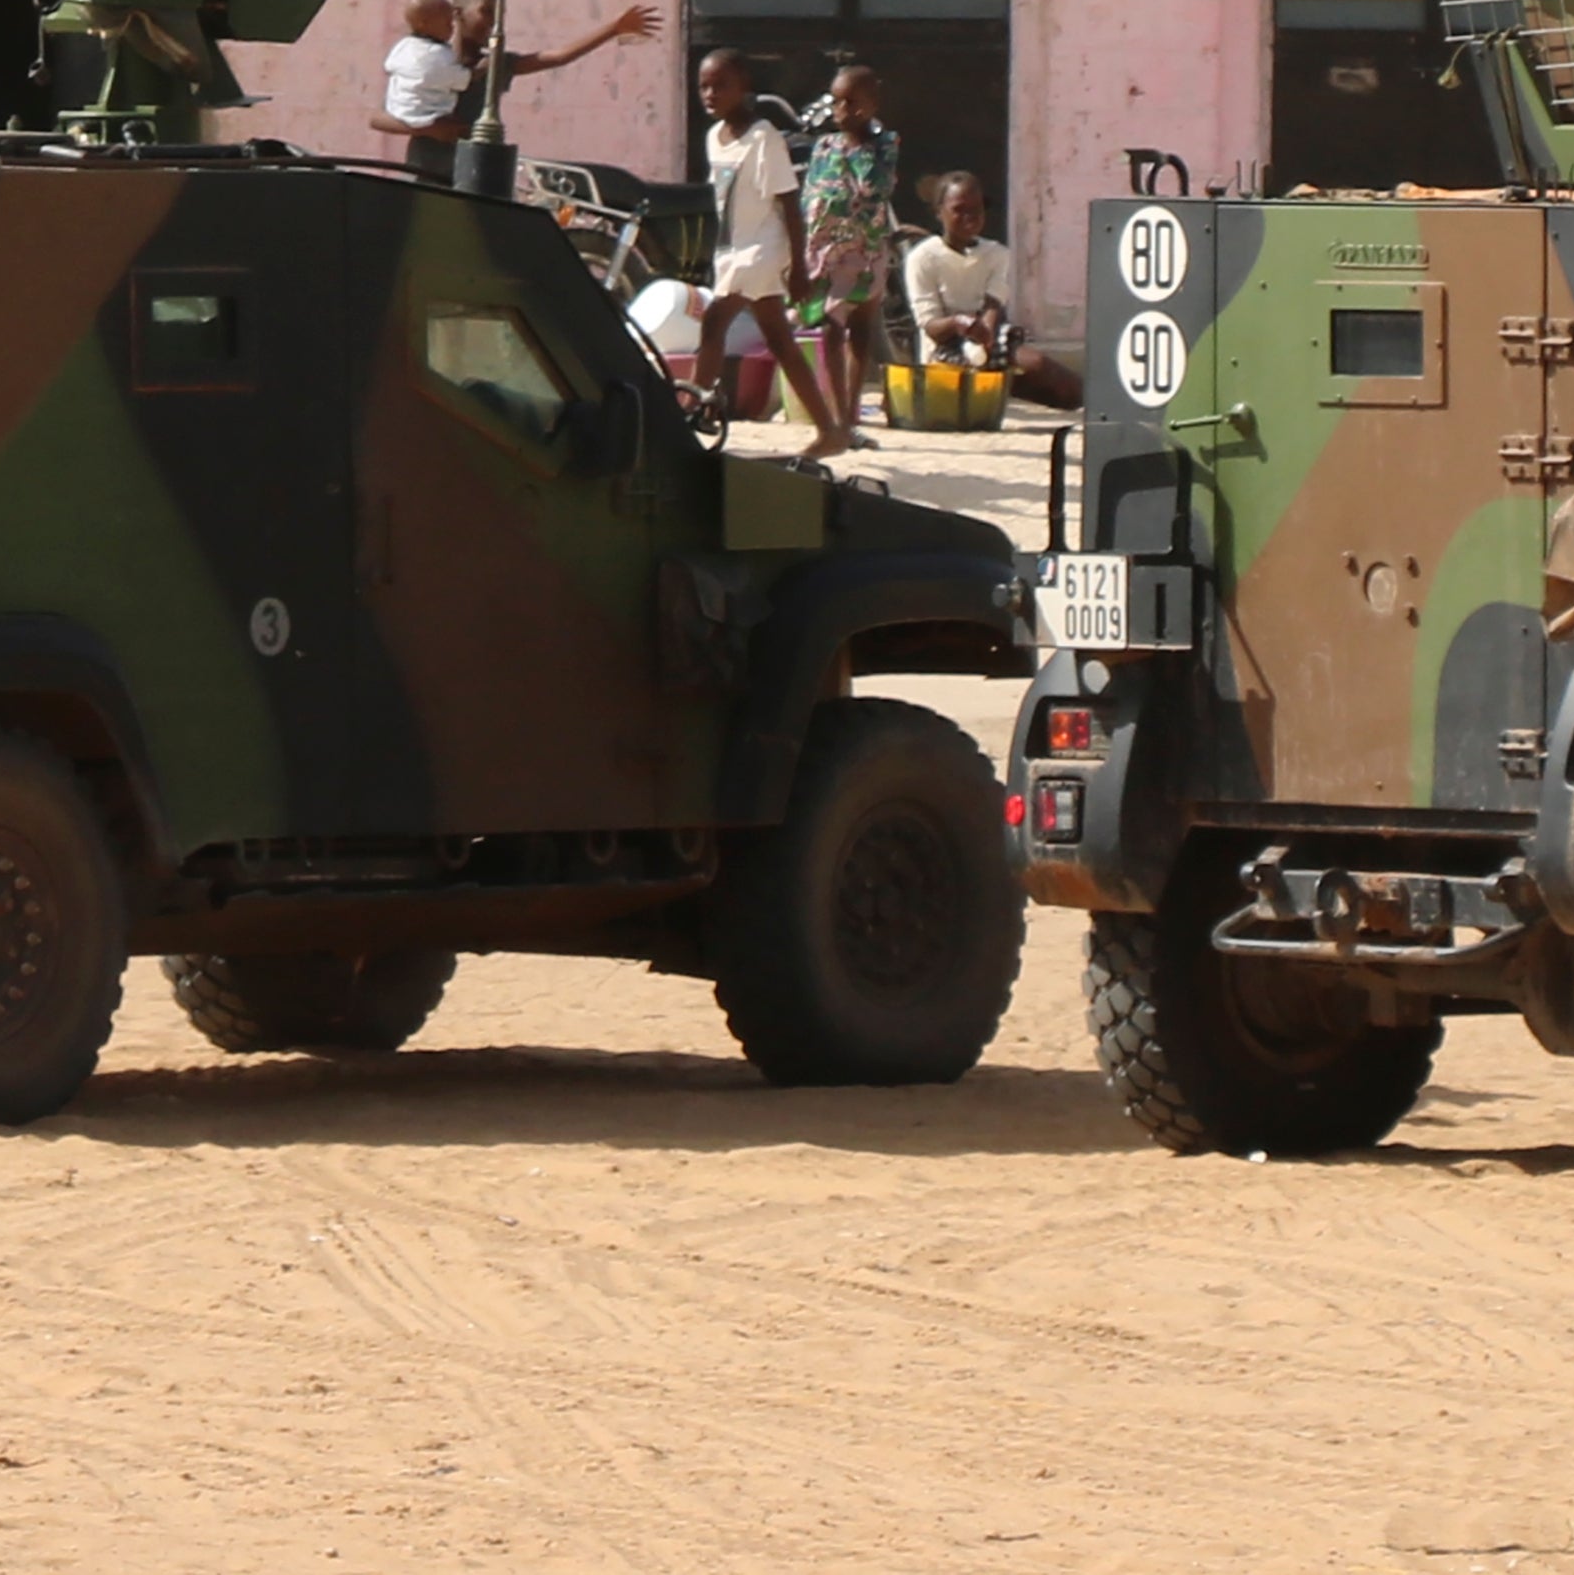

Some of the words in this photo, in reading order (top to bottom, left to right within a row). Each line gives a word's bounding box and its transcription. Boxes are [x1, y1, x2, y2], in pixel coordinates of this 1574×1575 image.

[1132, 220, 1174, 289] 80
[1130, 324, 1173, 394] 90
[1066, 563, 1120, 600] 6121
[261, 604, 280, 647] 3
[1066, 604, 1122, 641] 0009
